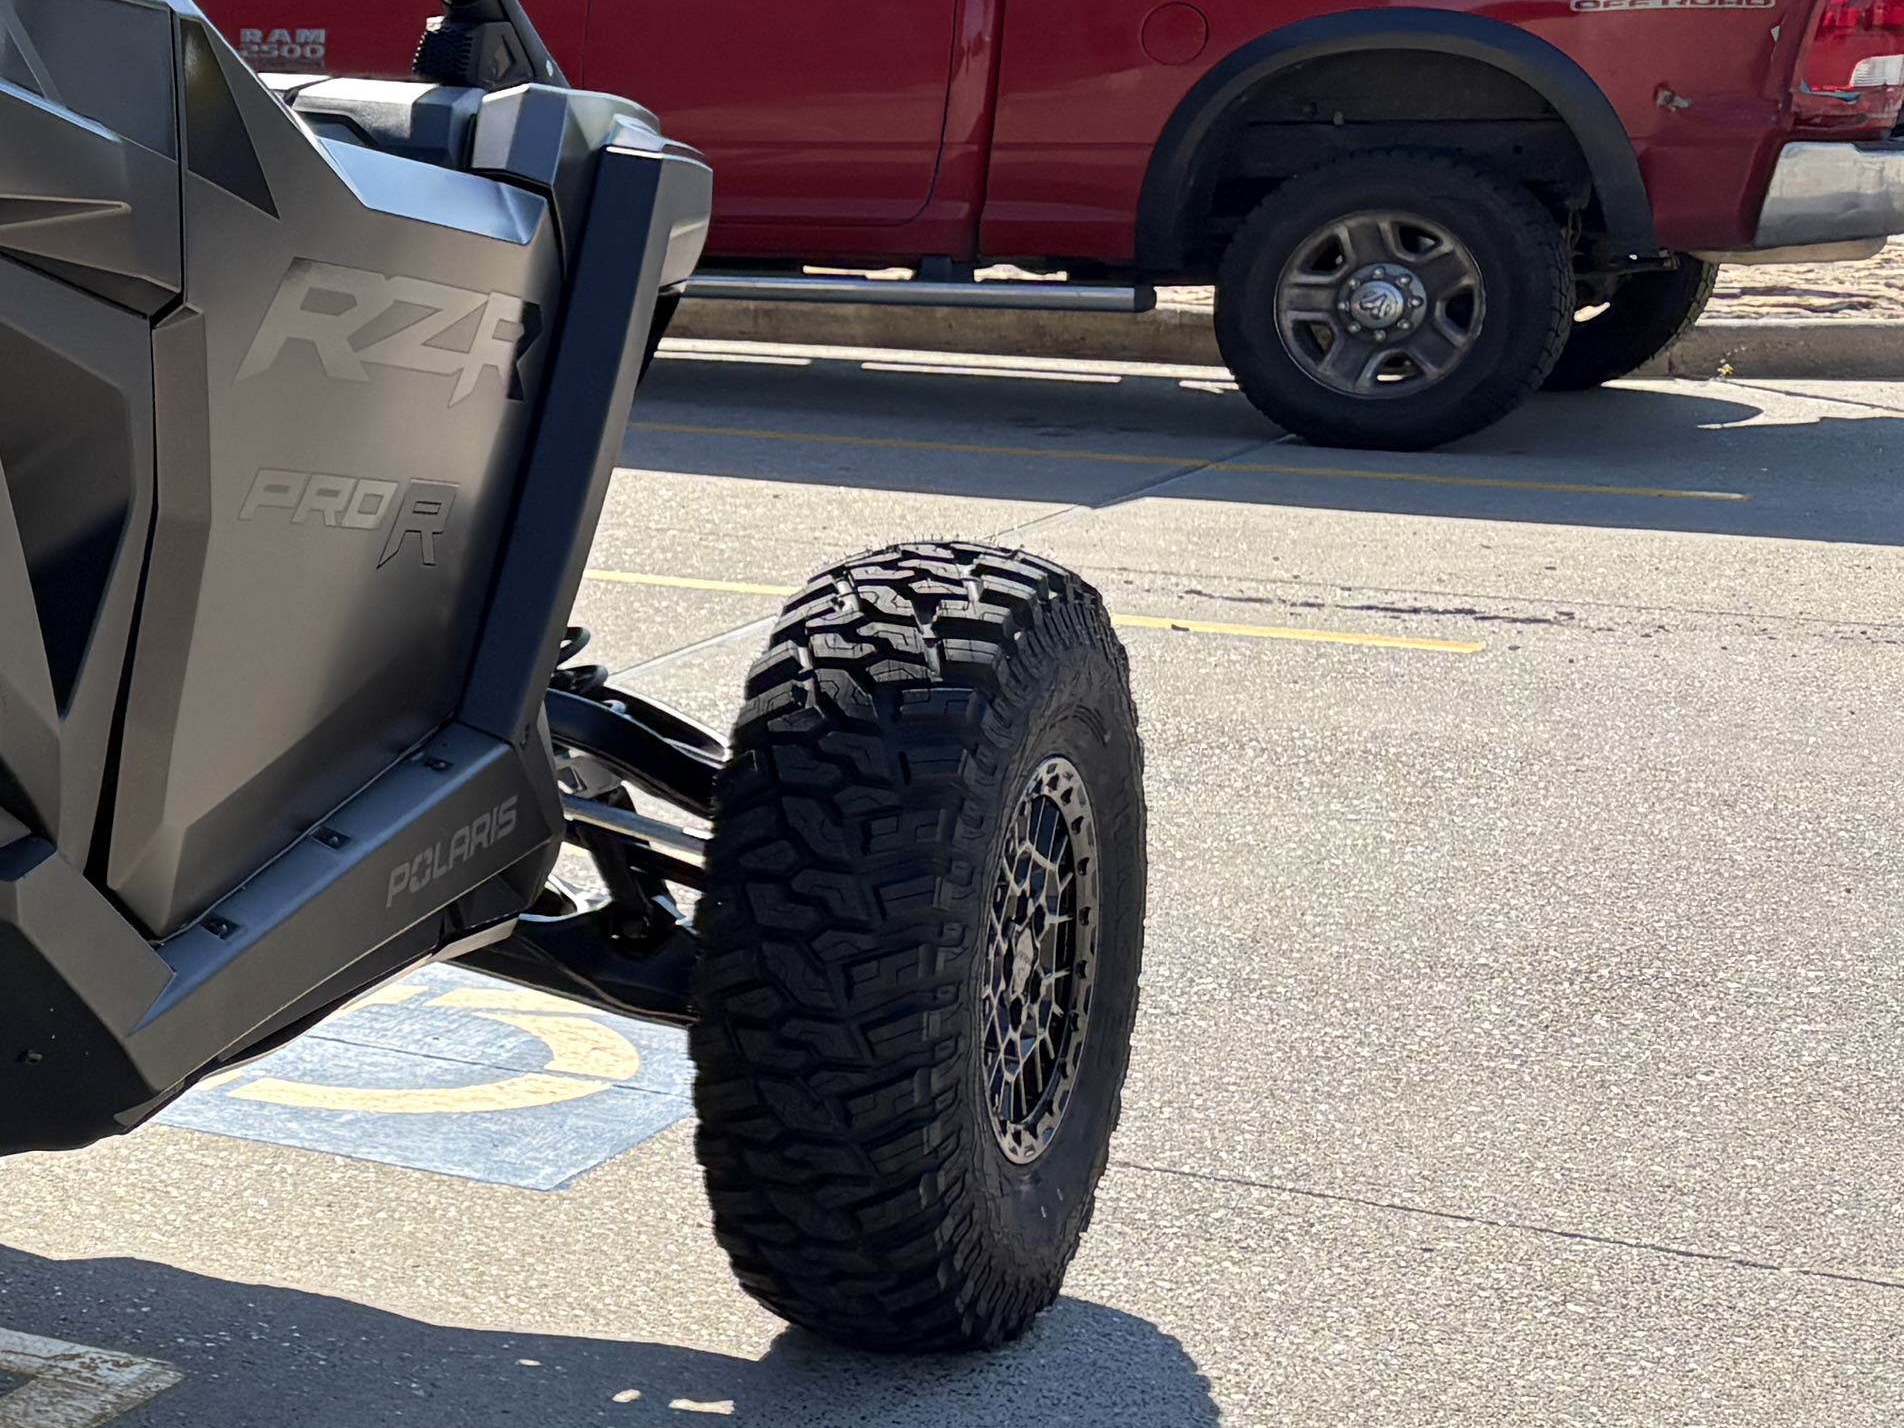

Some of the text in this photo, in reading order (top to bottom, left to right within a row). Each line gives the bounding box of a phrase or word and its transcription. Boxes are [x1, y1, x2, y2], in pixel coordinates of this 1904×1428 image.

[239, 44, 326, 59] 2500
[240, 28, 326, 45] RAM
[235, 257, 542, 408] RZR
[237, 468, 461, 570] PRO R
[385, 795, 518, 908] POLARIS
